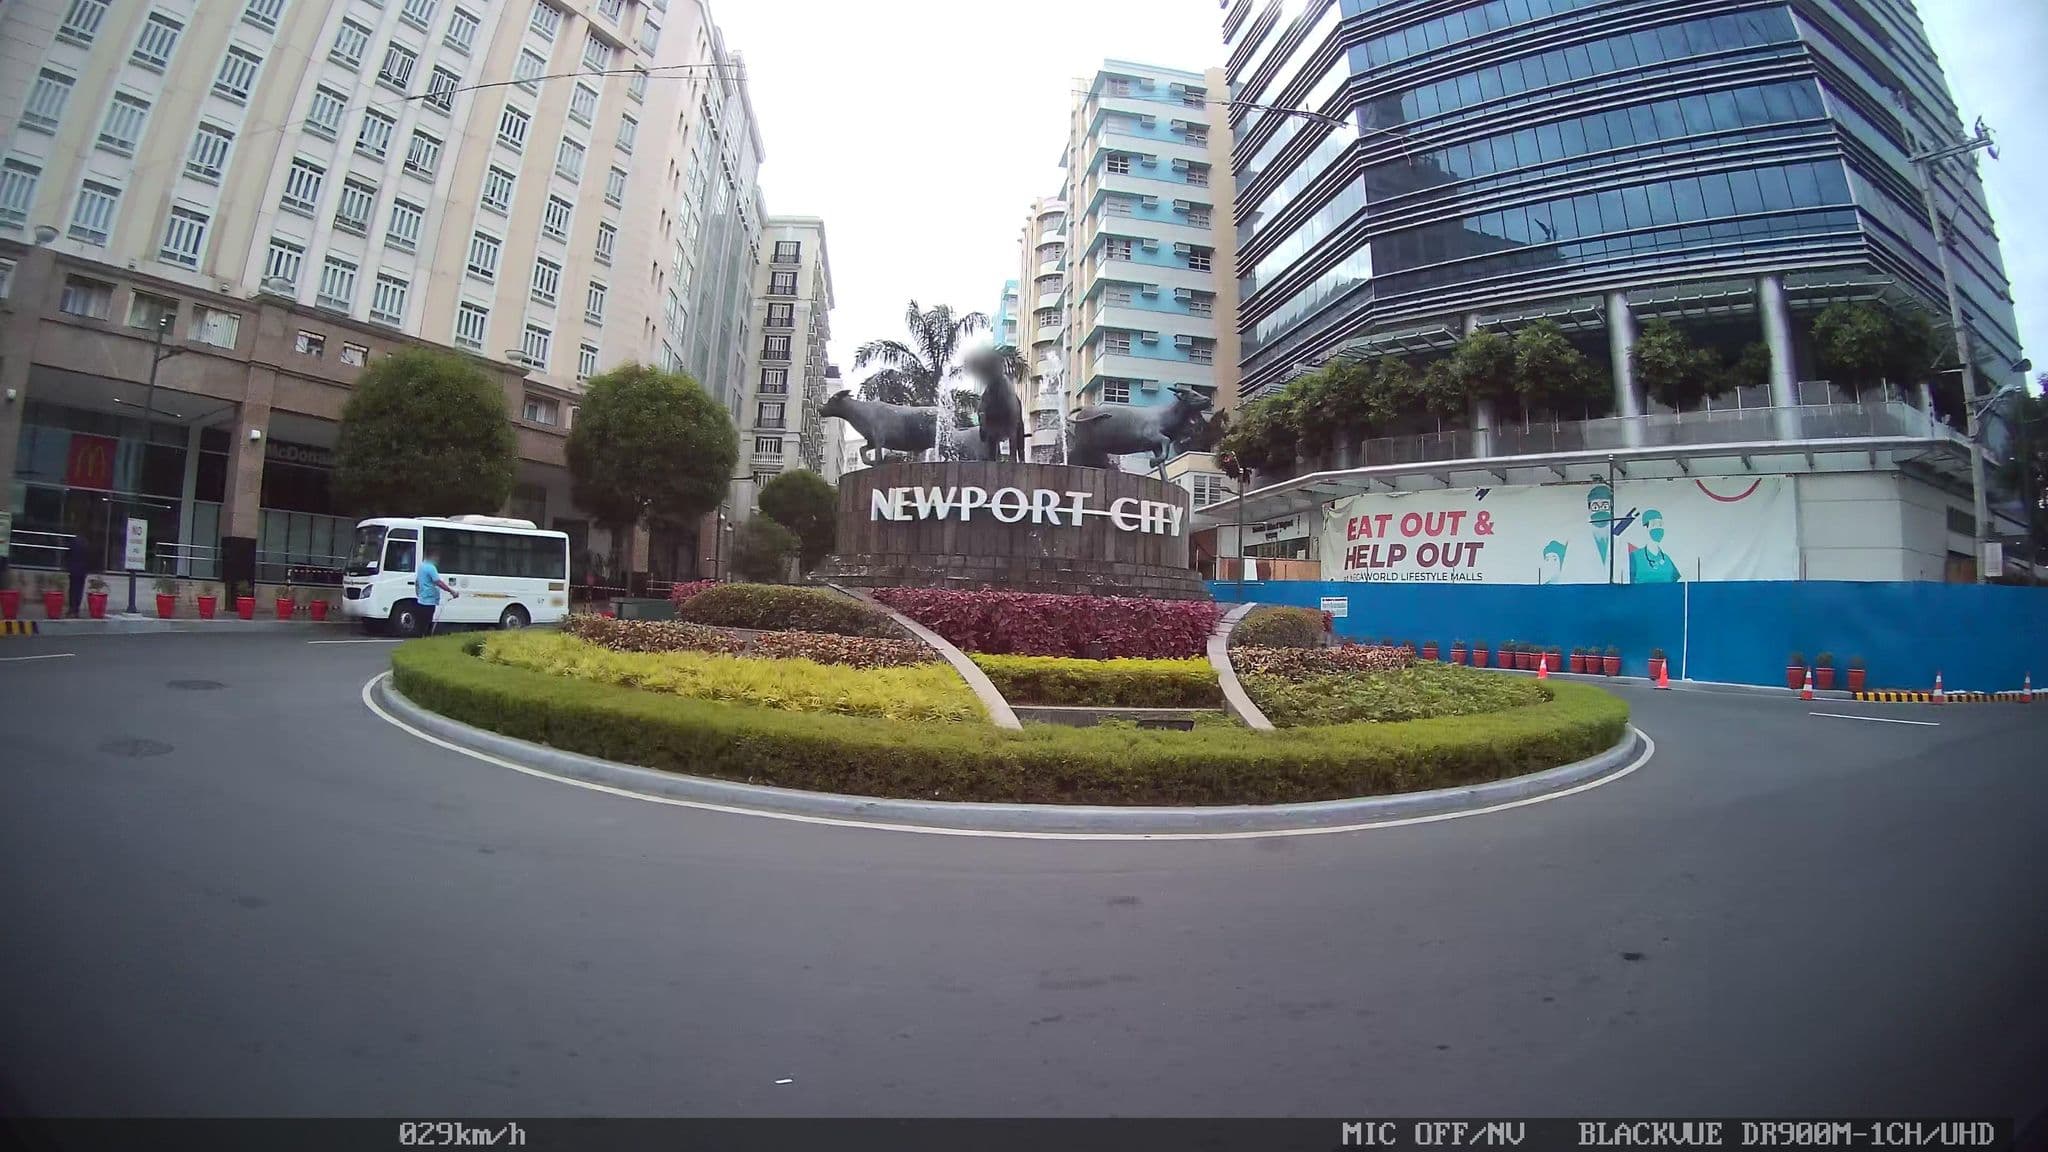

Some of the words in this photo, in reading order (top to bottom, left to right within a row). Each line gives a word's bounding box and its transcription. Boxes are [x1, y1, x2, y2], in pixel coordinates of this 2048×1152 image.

[870, 486, 1093, 527] NEWPORT
[1109, 497, 1184, 537] CITY
[1346, 513, 1393, 541] EAT
[1400, 510, 1467, 537] OUT
[1474, 510, 1495, 536] &
[1344, 543, 1407, 570] HELP
[1416, 542, 1485, 568] OUT
[1401, 572, 1448, 581] LIFESTYLE
[1451, 572, 1483, 581] MALLS
